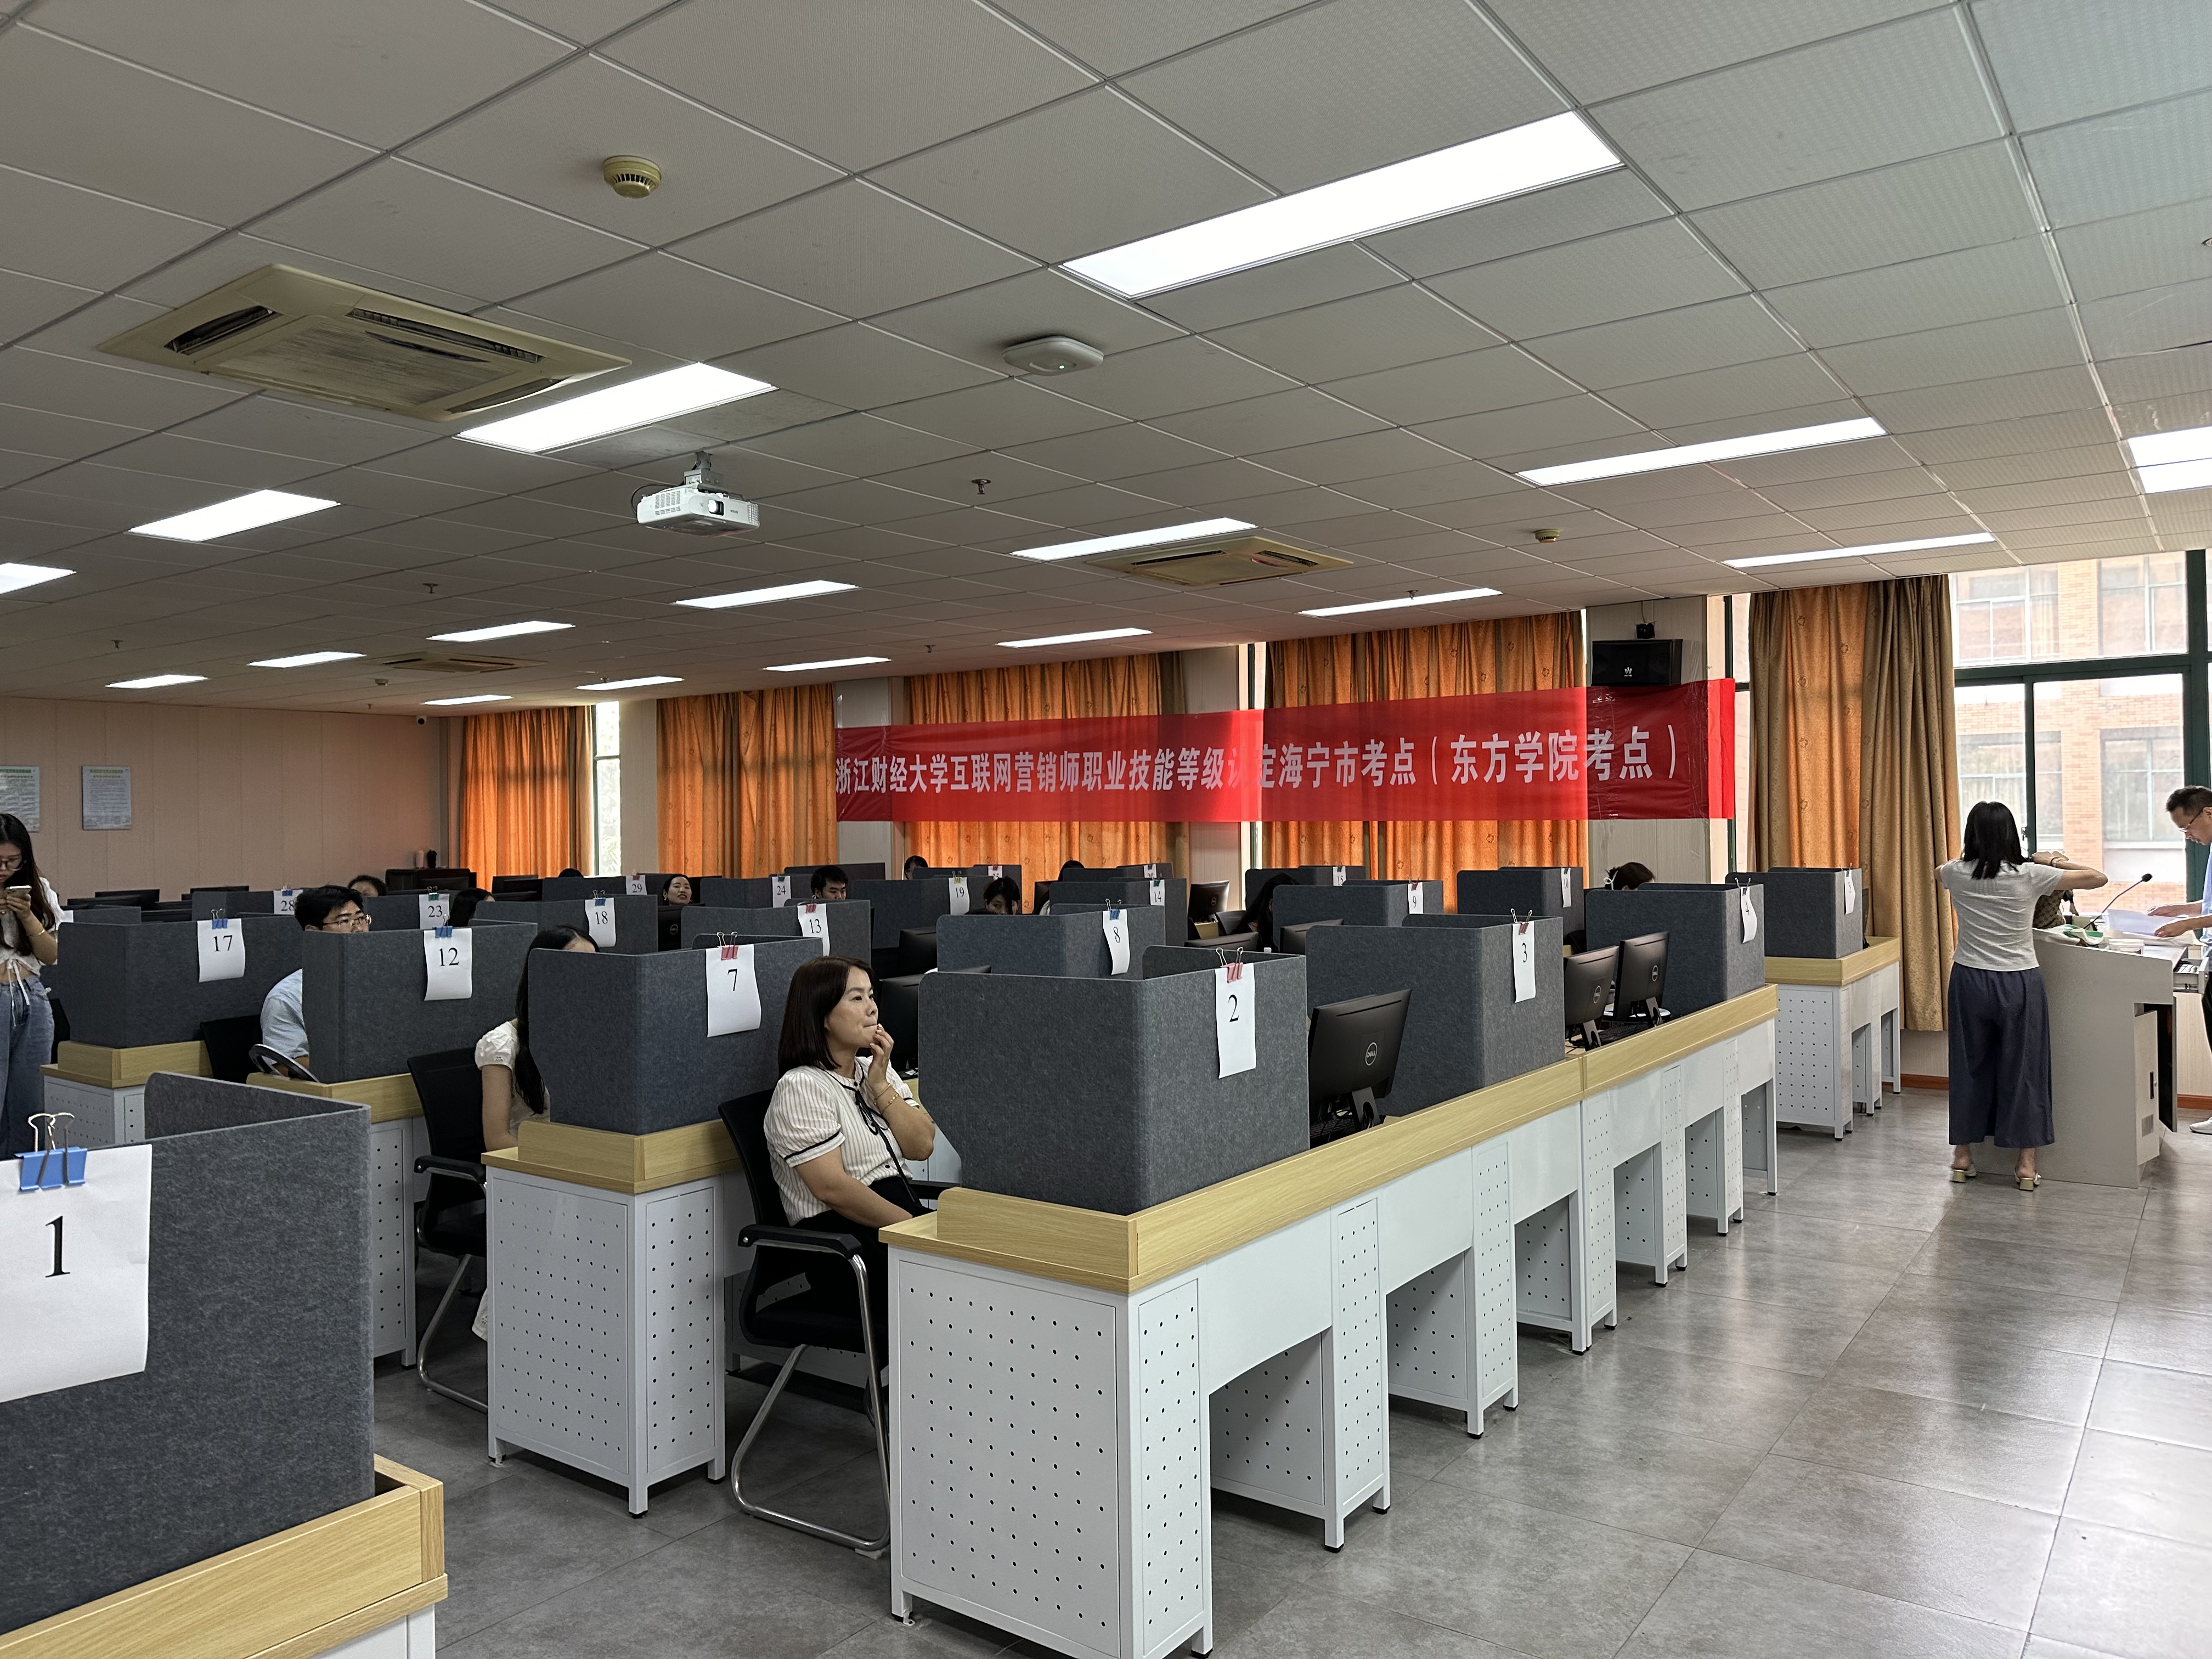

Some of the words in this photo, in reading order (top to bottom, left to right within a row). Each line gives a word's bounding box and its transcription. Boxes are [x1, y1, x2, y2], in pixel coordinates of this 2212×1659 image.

[632, 883, 642, 893] 29
[776, 885, 786, 895] 24
[1564, 878, 1569, 889] 10
[955, 887, 964, 898] 19
[1154, 890, 1161, 902] 14
[280, 900, 295, 911] 28
[1413, 895, 1417, 909] 9
[1745, 901, 1750, 916] 4
[428, 905, 443, 918] 23
[595, 911, 608, 925] 18
[809, 918, 822, 934] 13
[1113, 926, 1121, 943] 8
[213, 935, 233, 952] 17
[438, 947, 460, 967] 12
[1522, 942, 1527, 963] 3
[727, 968, 738, 992] 7
[1228, 994, 1240, 1023] 2
[45, 1215, 71, 1278] 1
